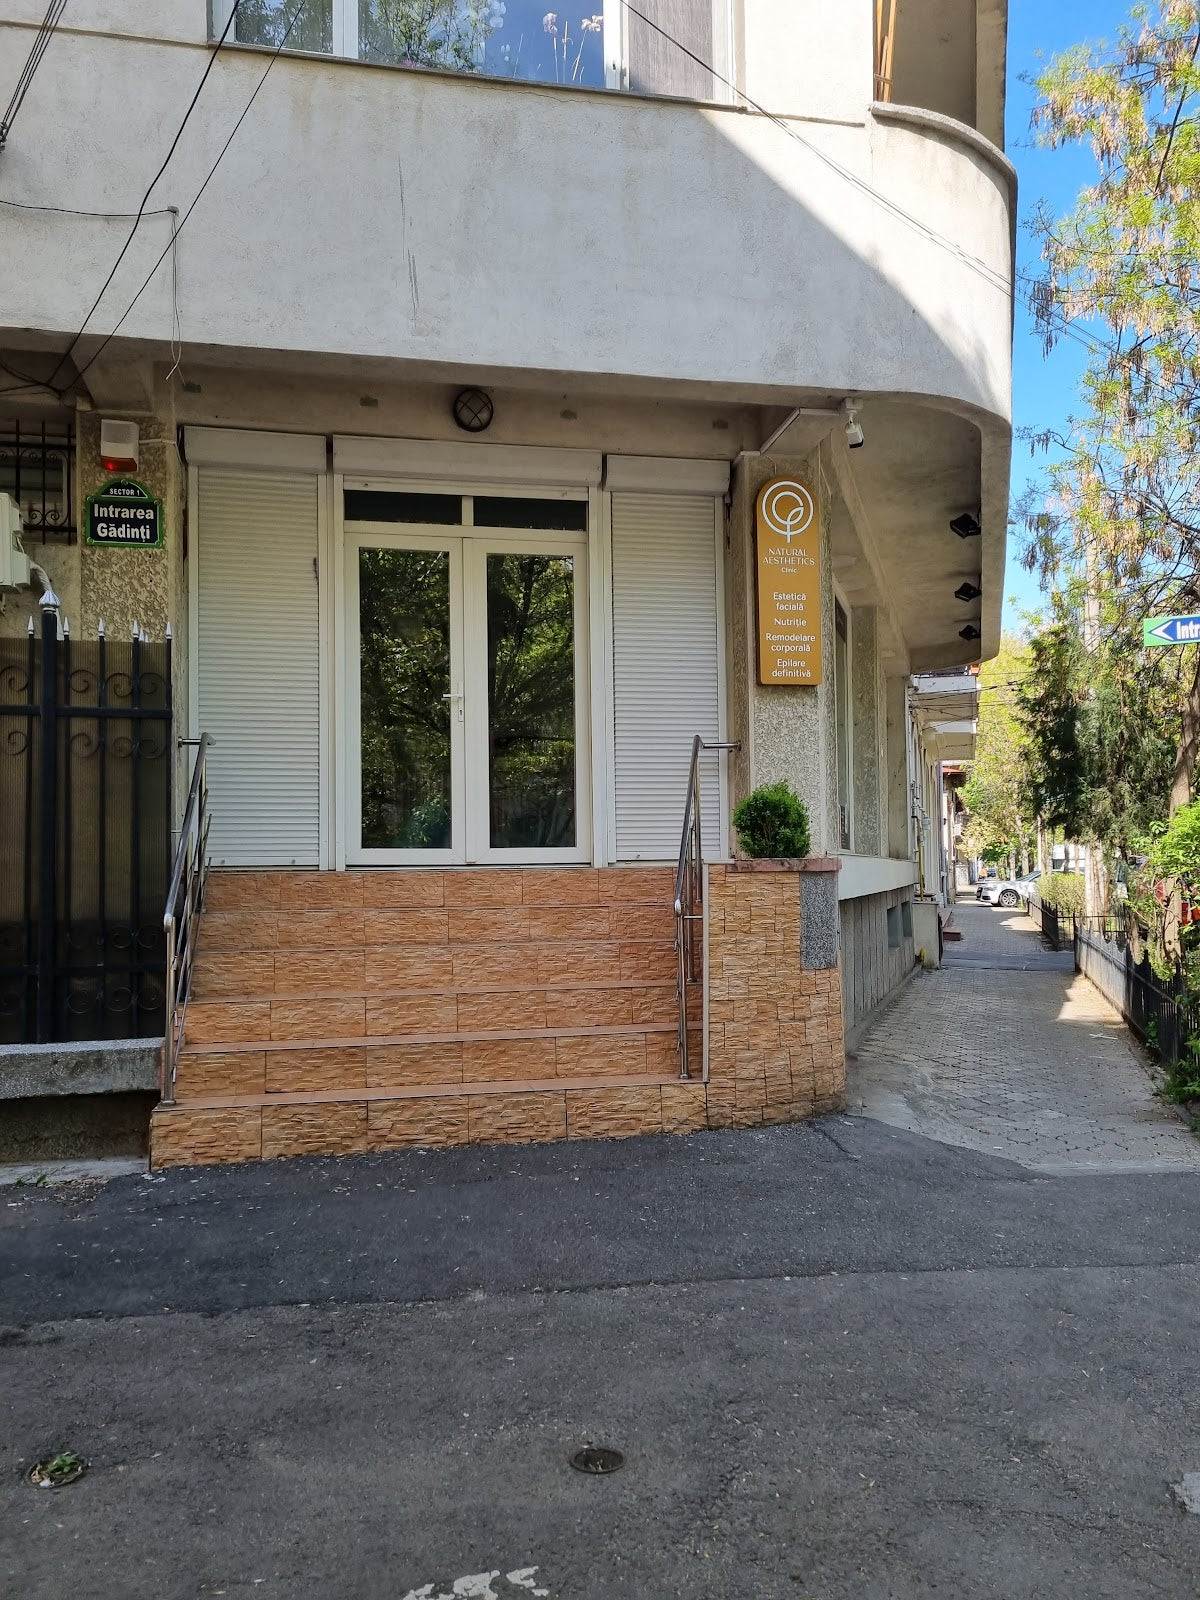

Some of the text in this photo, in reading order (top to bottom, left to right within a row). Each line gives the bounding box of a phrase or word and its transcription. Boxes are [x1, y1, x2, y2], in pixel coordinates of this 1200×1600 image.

[109, 487, 135, 496] SECTOR
[94, 503, 154, 520] Intrarea
[768, 547, 808, 557] NATURAL
[762, 556, 815, 566] AESTHETICS
[781, 566, 797, 574] Clinic
[773, 591, 807, 601] Estetică
[776, 602, 804, 611] facială
[774, 617, 807, 628] Nutriție
[765, 632, 816, 642] Remodelare
[771, 643, 811, 653] corporală
[777, 658, 806, 669] Epilare
[771, 668, 811, 678] definitivă
